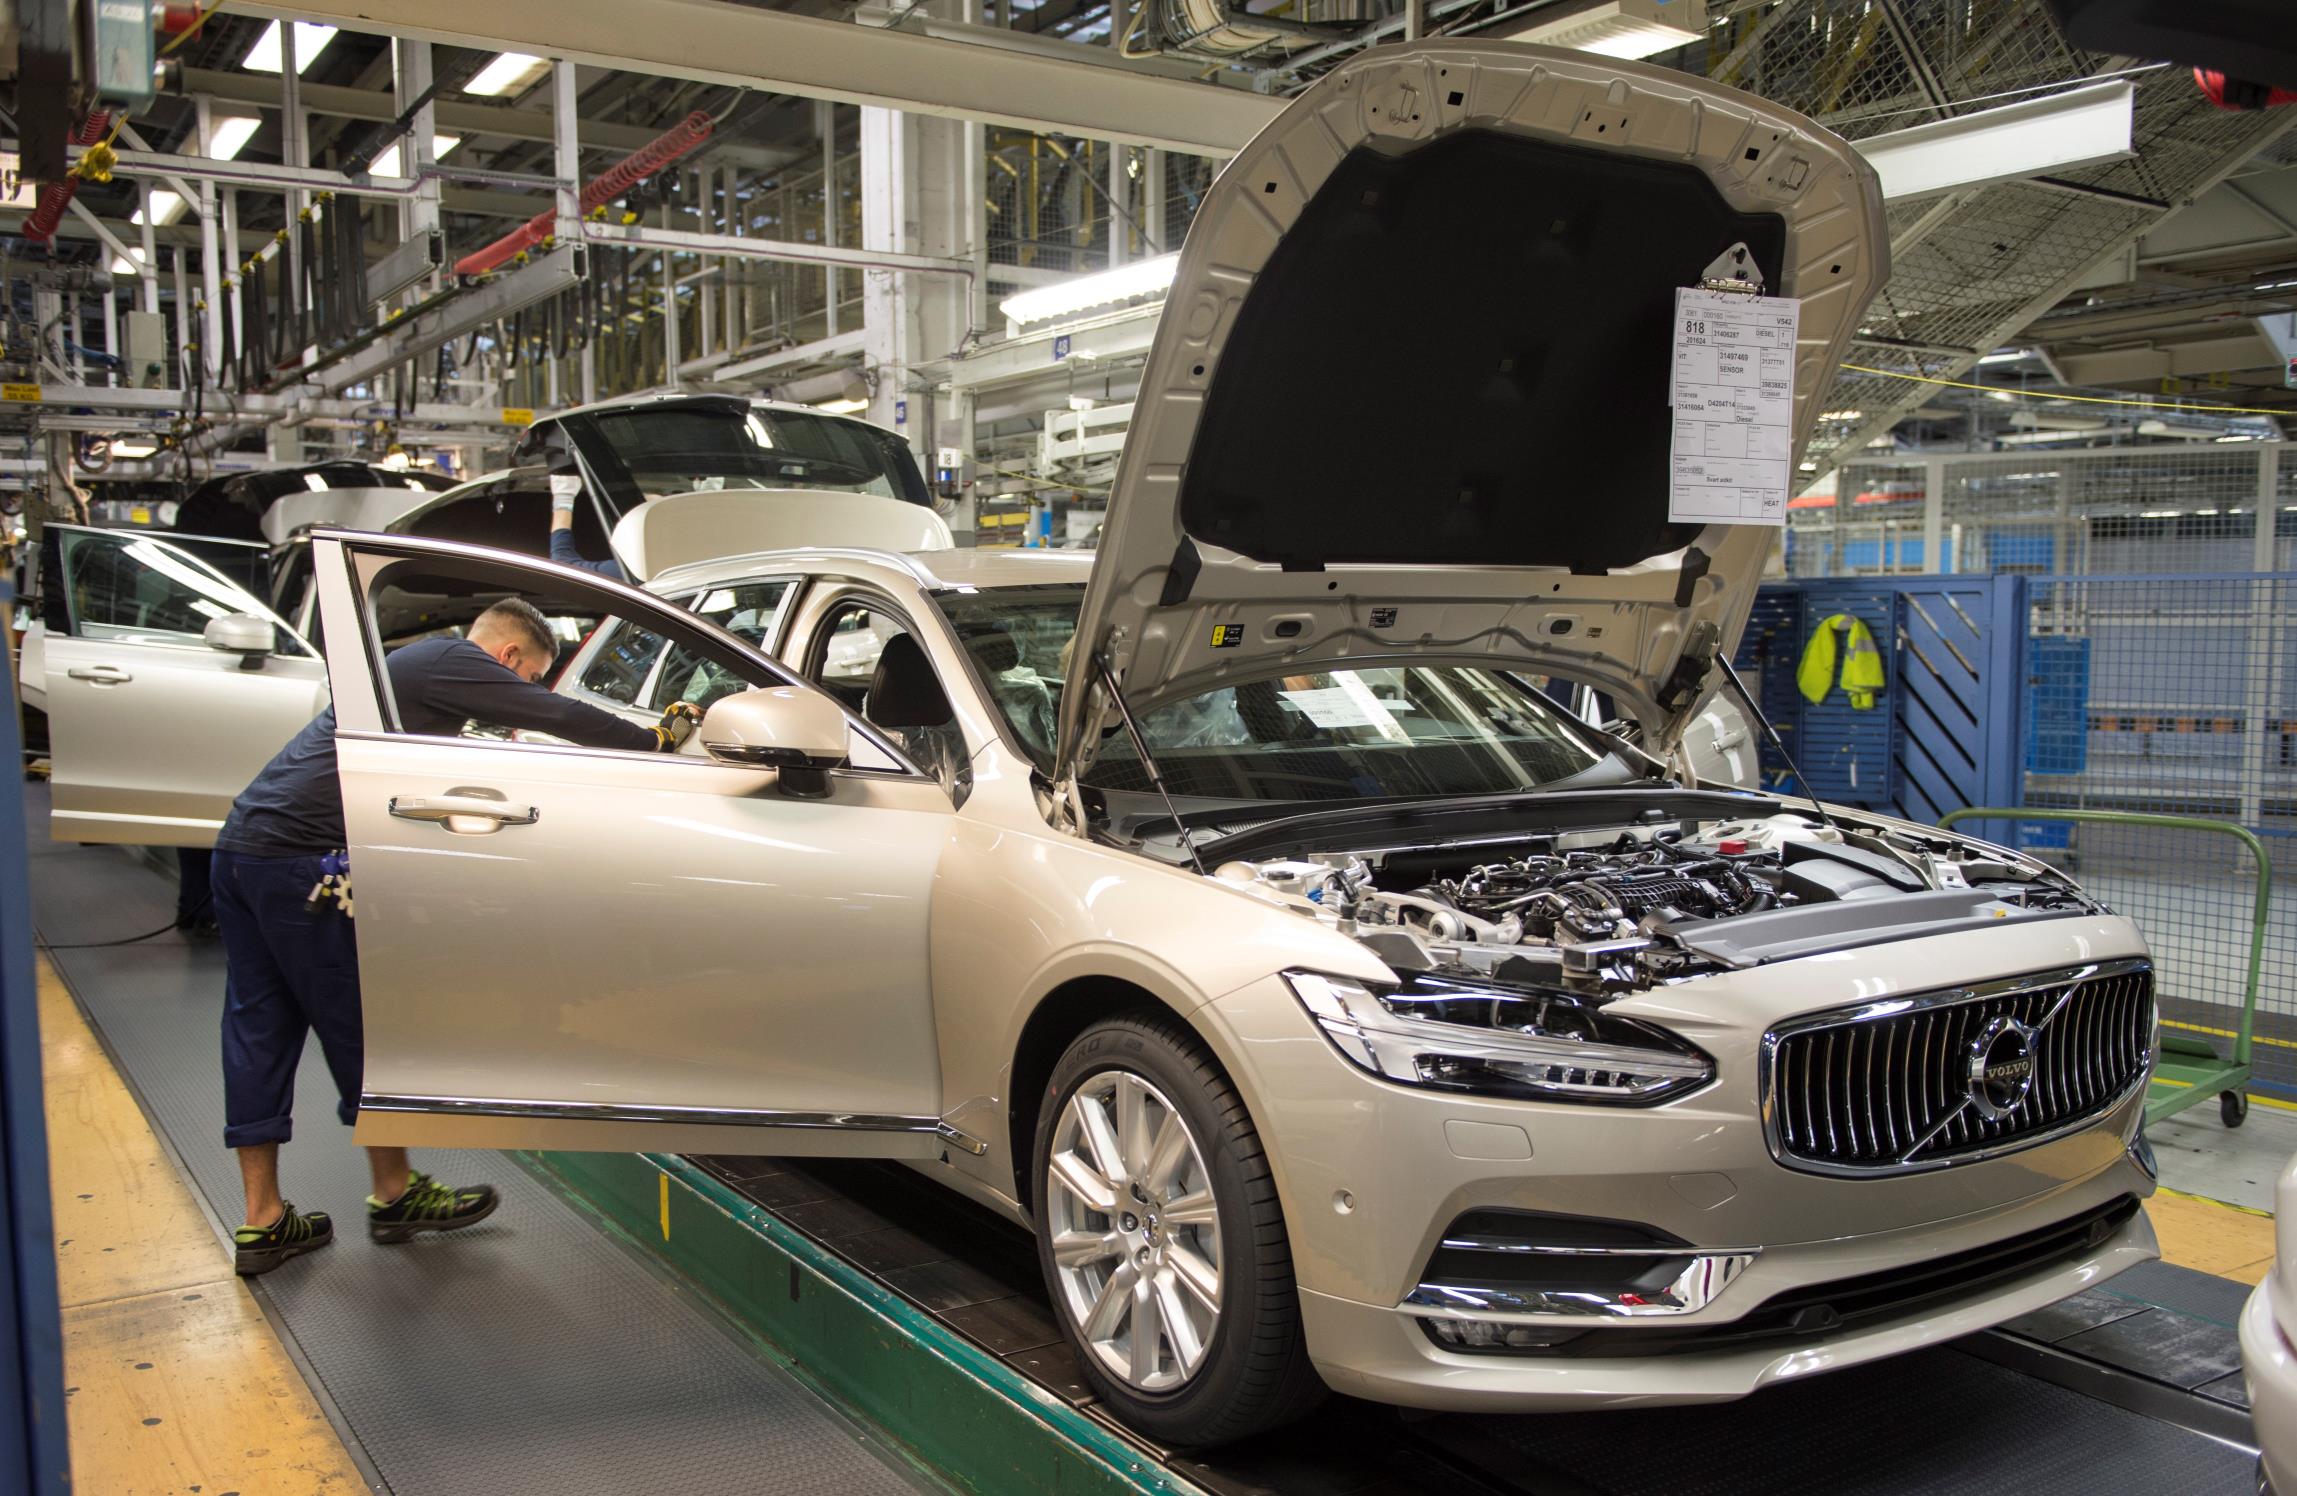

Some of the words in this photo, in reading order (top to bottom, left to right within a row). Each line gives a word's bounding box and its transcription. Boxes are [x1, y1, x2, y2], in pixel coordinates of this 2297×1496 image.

[1686, 321, 1704, 333] 818
[1686, 336, 1706, 344] 201624
[1057, 339, 1069, 354] 48
[1719, 365, 1745, 374] SENSOR
[1736, 415, 1754, 423] Diesel
[1987, 1060, 2030, 1080] VOLVO
